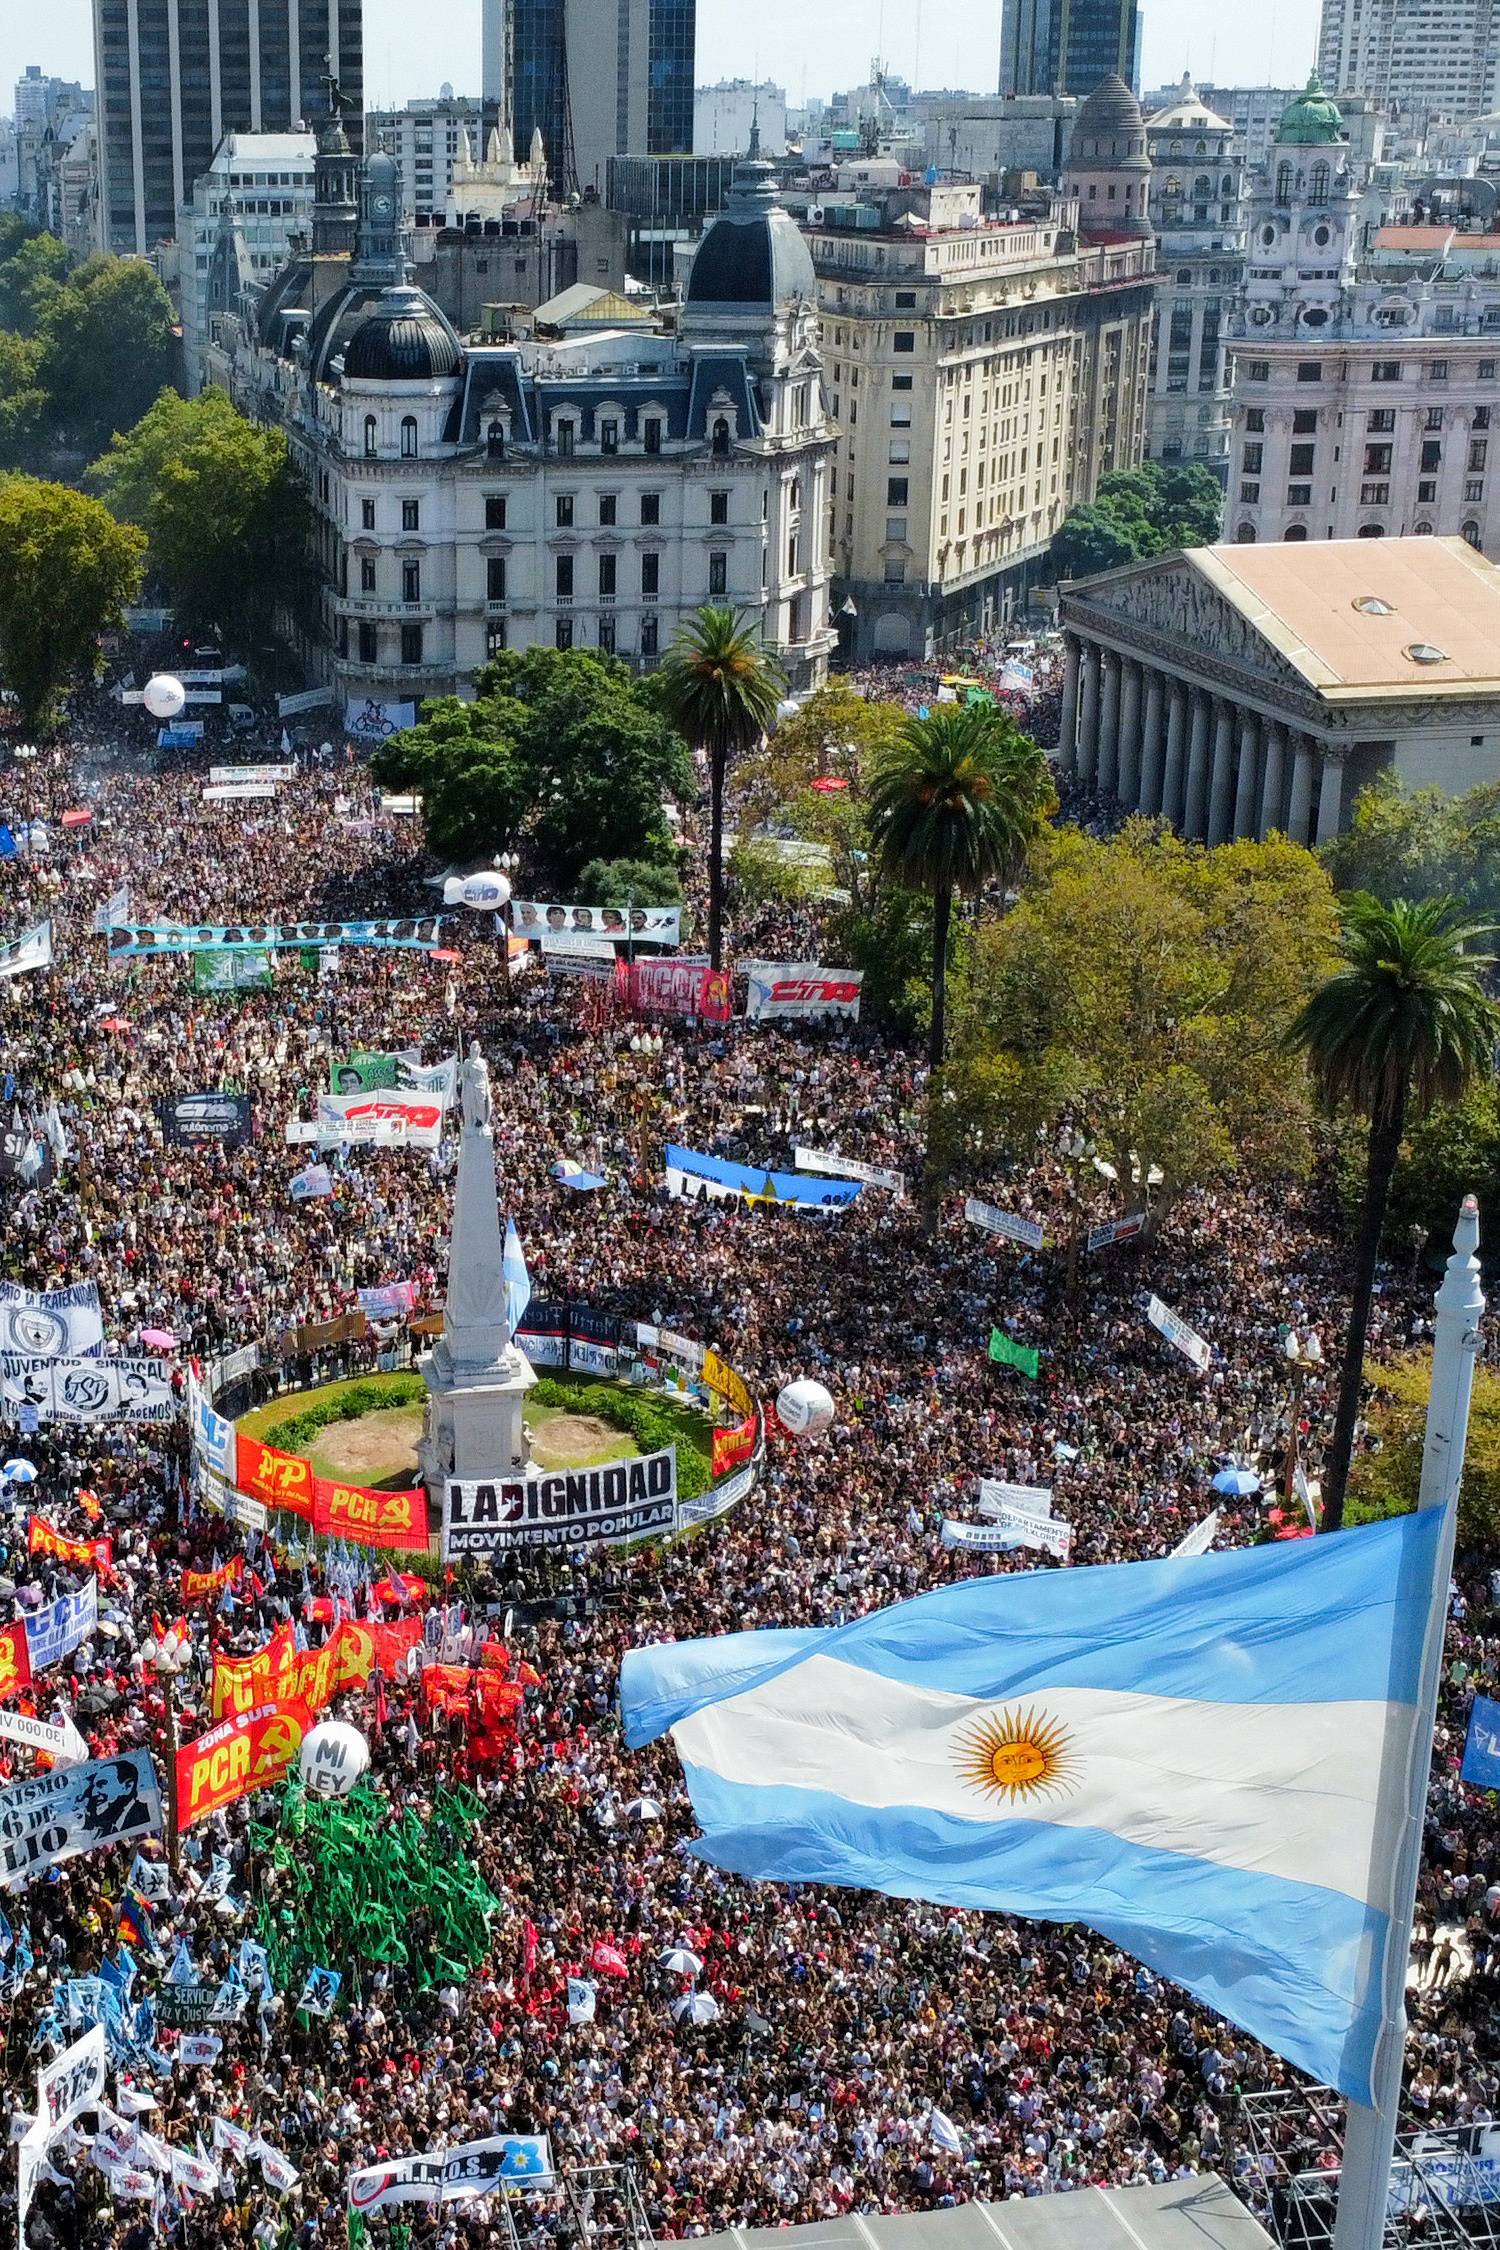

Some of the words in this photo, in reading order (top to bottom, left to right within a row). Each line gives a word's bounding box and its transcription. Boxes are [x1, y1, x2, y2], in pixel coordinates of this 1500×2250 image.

[25, 1292, 35, 1306] LA
[3, 1357, 82, 1379] JUVENTUD
[96, 1359, 167, 1383] SINDICAL
[46, 1409, 83, 1421] UNIDOS
[94, 1400, 172, 1421] TRIUNFAREMOS
[329, 1488, 378, 1523] PCR
[451, 1524, 585, 1550] MOVIMIENTO
[587, 1505, 674, 1538] POPULAR
[1001, 1512, 1069, 1540] DEPARTAMENTO
[32, 1526, 70, 1558] PCR
[197, 1723, 234, 1753] ZONA
[237, 1704, 279, 1729] SUR
[315, 1738, 348, 1768] MI
[190, 1735, 251, 1807] PCR
[306, 1766, 348, 1792] LEY
[28, 1804, 58, 1830] DE
[4, 1826, 68, 1871] LIO
[155, 2001, 173, 2020] PAZ
[174, 2006, 182, 2021] Y
